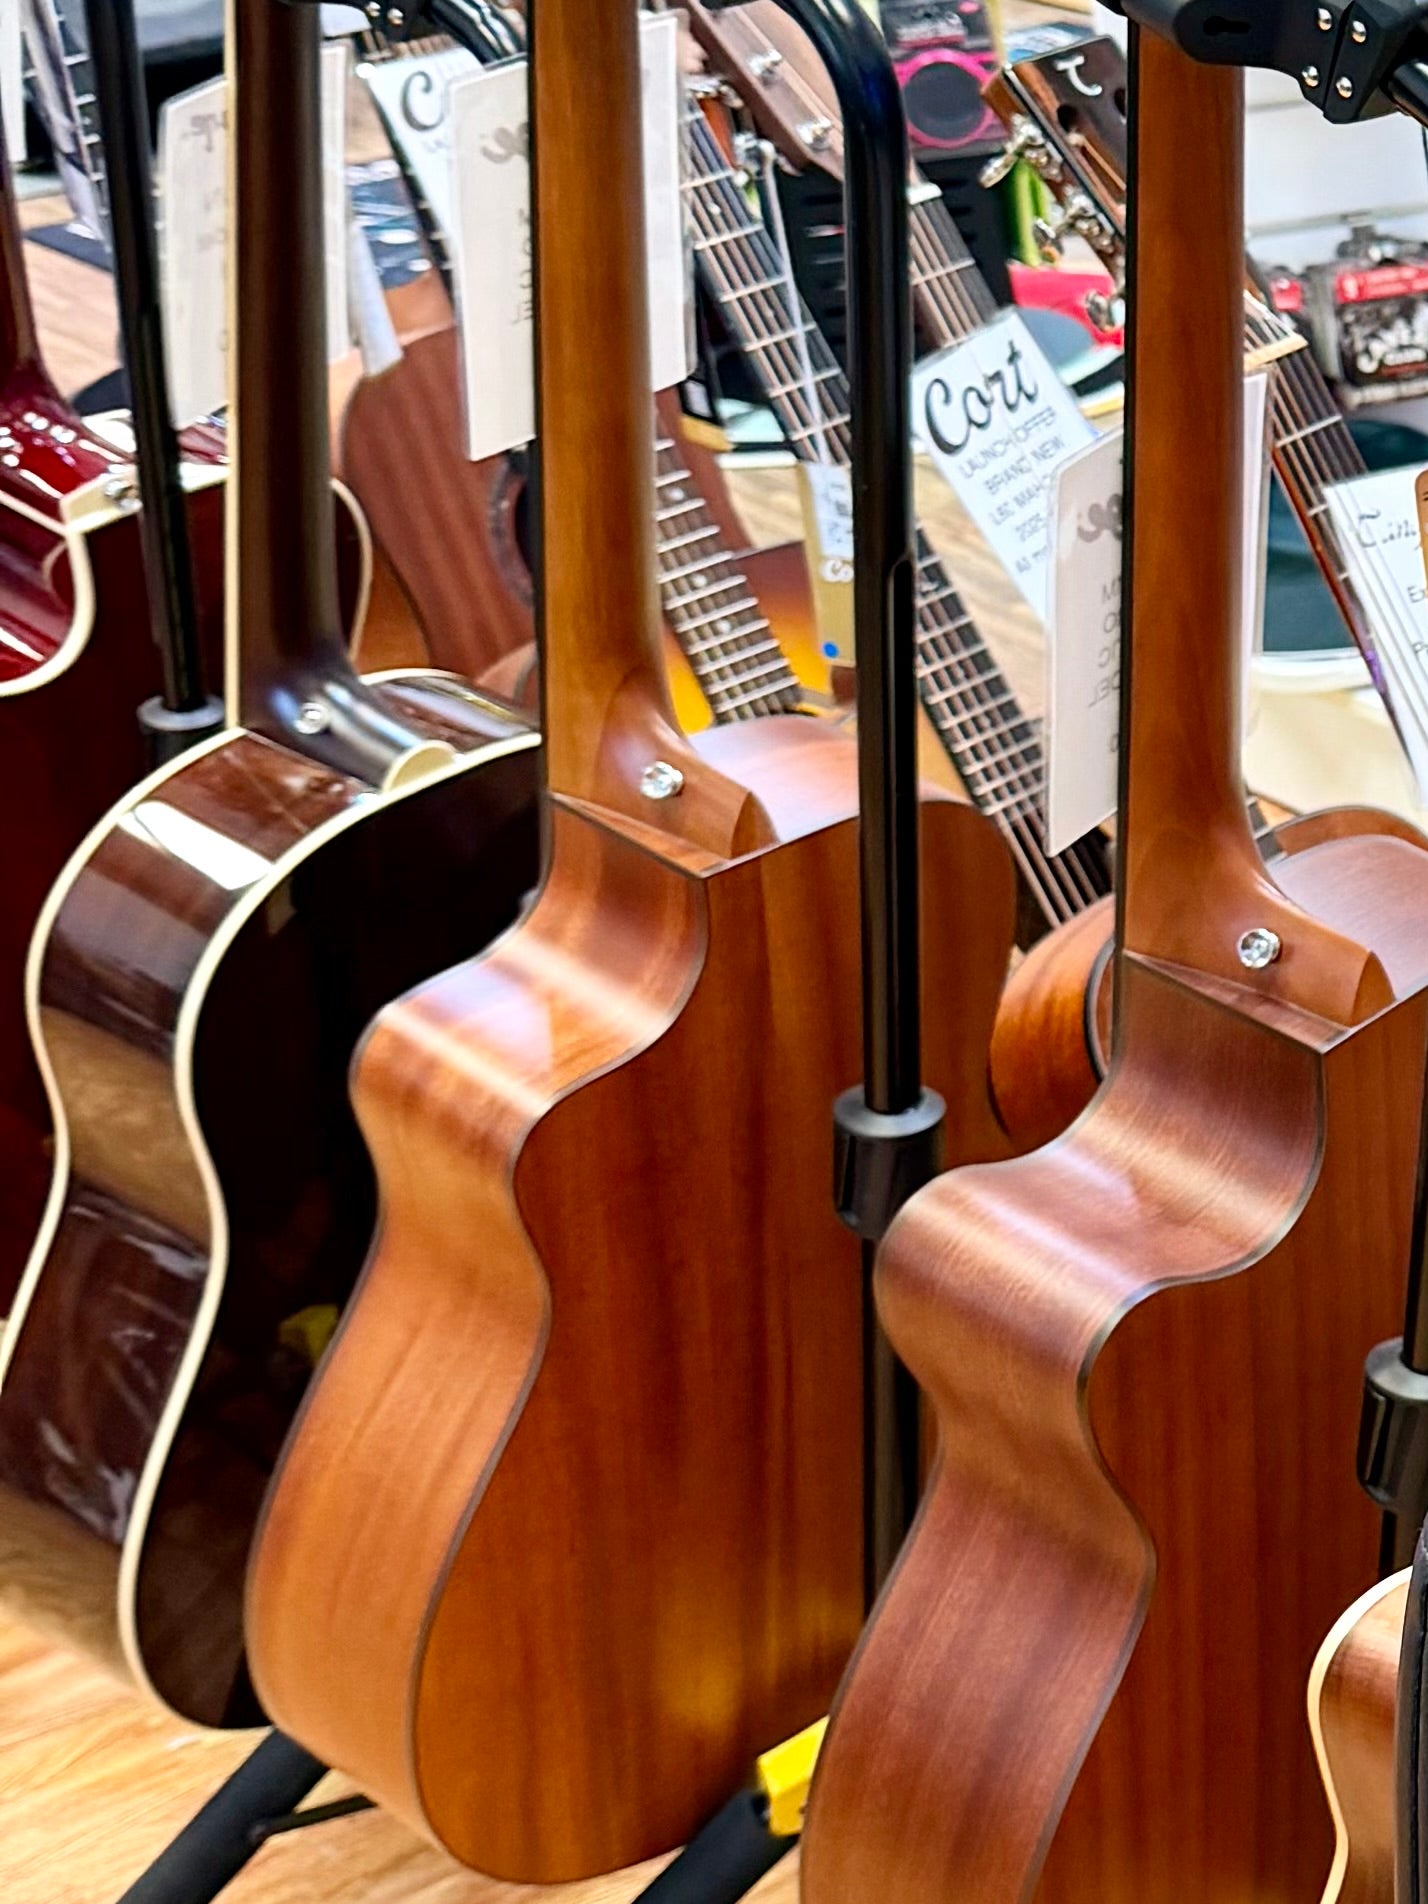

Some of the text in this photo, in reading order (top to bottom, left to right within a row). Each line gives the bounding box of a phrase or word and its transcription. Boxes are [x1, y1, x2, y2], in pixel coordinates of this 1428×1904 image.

[924, 337, 1039, 457] Cort
[984, 435, 1065, 496] BRAND NEW
